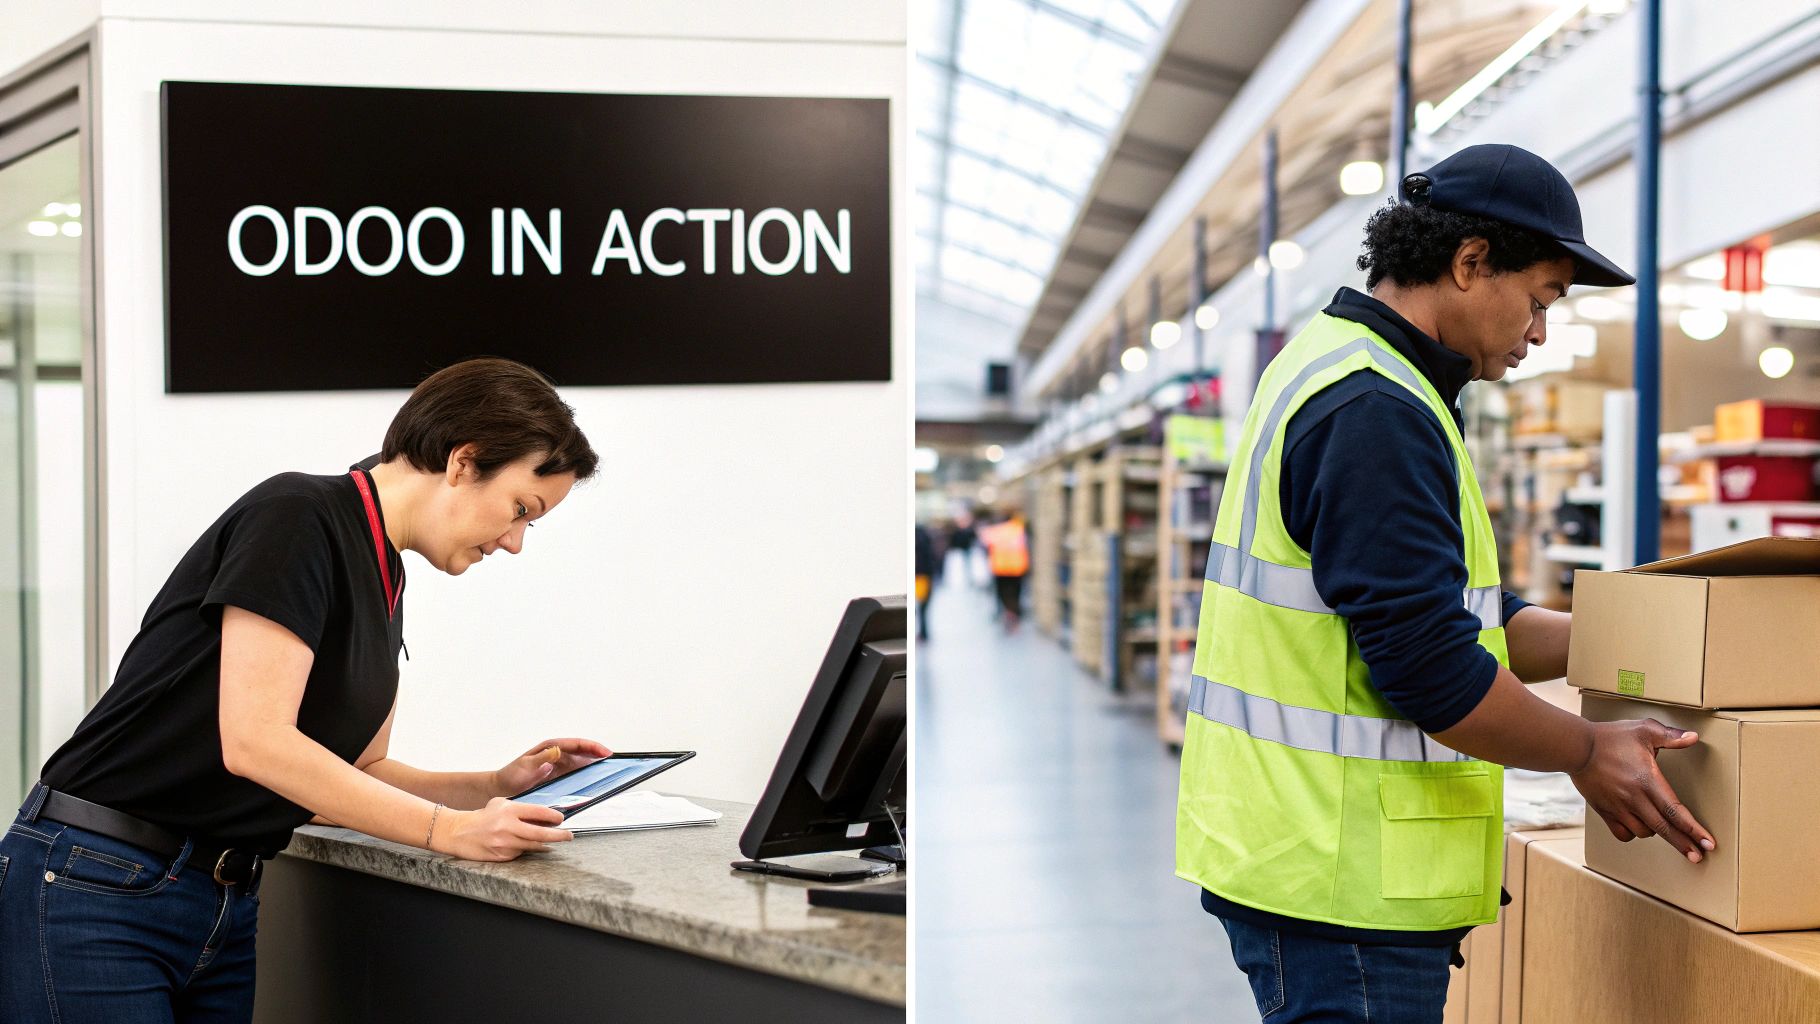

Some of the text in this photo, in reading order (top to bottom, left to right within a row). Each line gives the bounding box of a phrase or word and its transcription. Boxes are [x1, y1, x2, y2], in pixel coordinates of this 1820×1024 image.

[228, 205, 852, 277] ODOO IN ACTION
